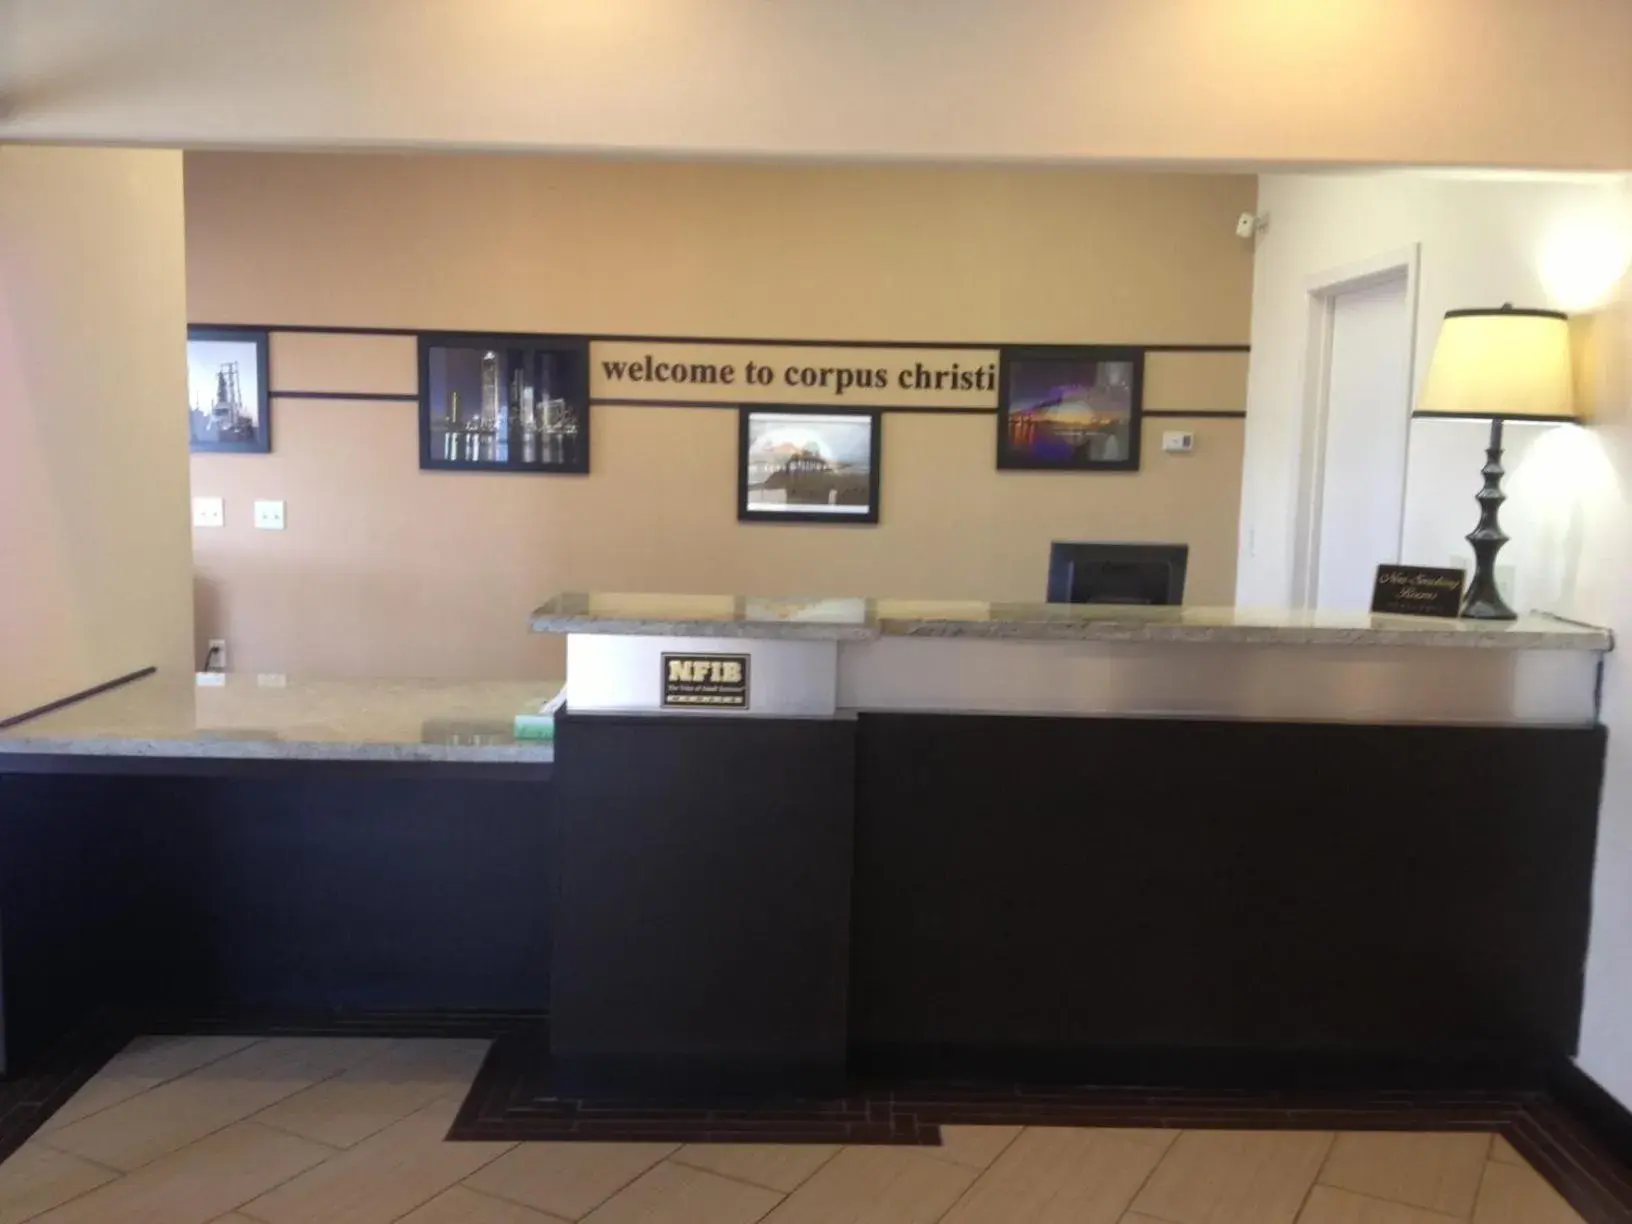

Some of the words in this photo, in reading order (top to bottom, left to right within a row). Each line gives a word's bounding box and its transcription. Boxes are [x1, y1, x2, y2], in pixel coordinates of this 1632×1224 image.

[602, 354, 735, 384] welcome
[745, 360, 774, 386] to
[784, 365, 888, 395] corpus
[898, 363, 996, 391] christi
[668, 660, 742, 683] NFIB
